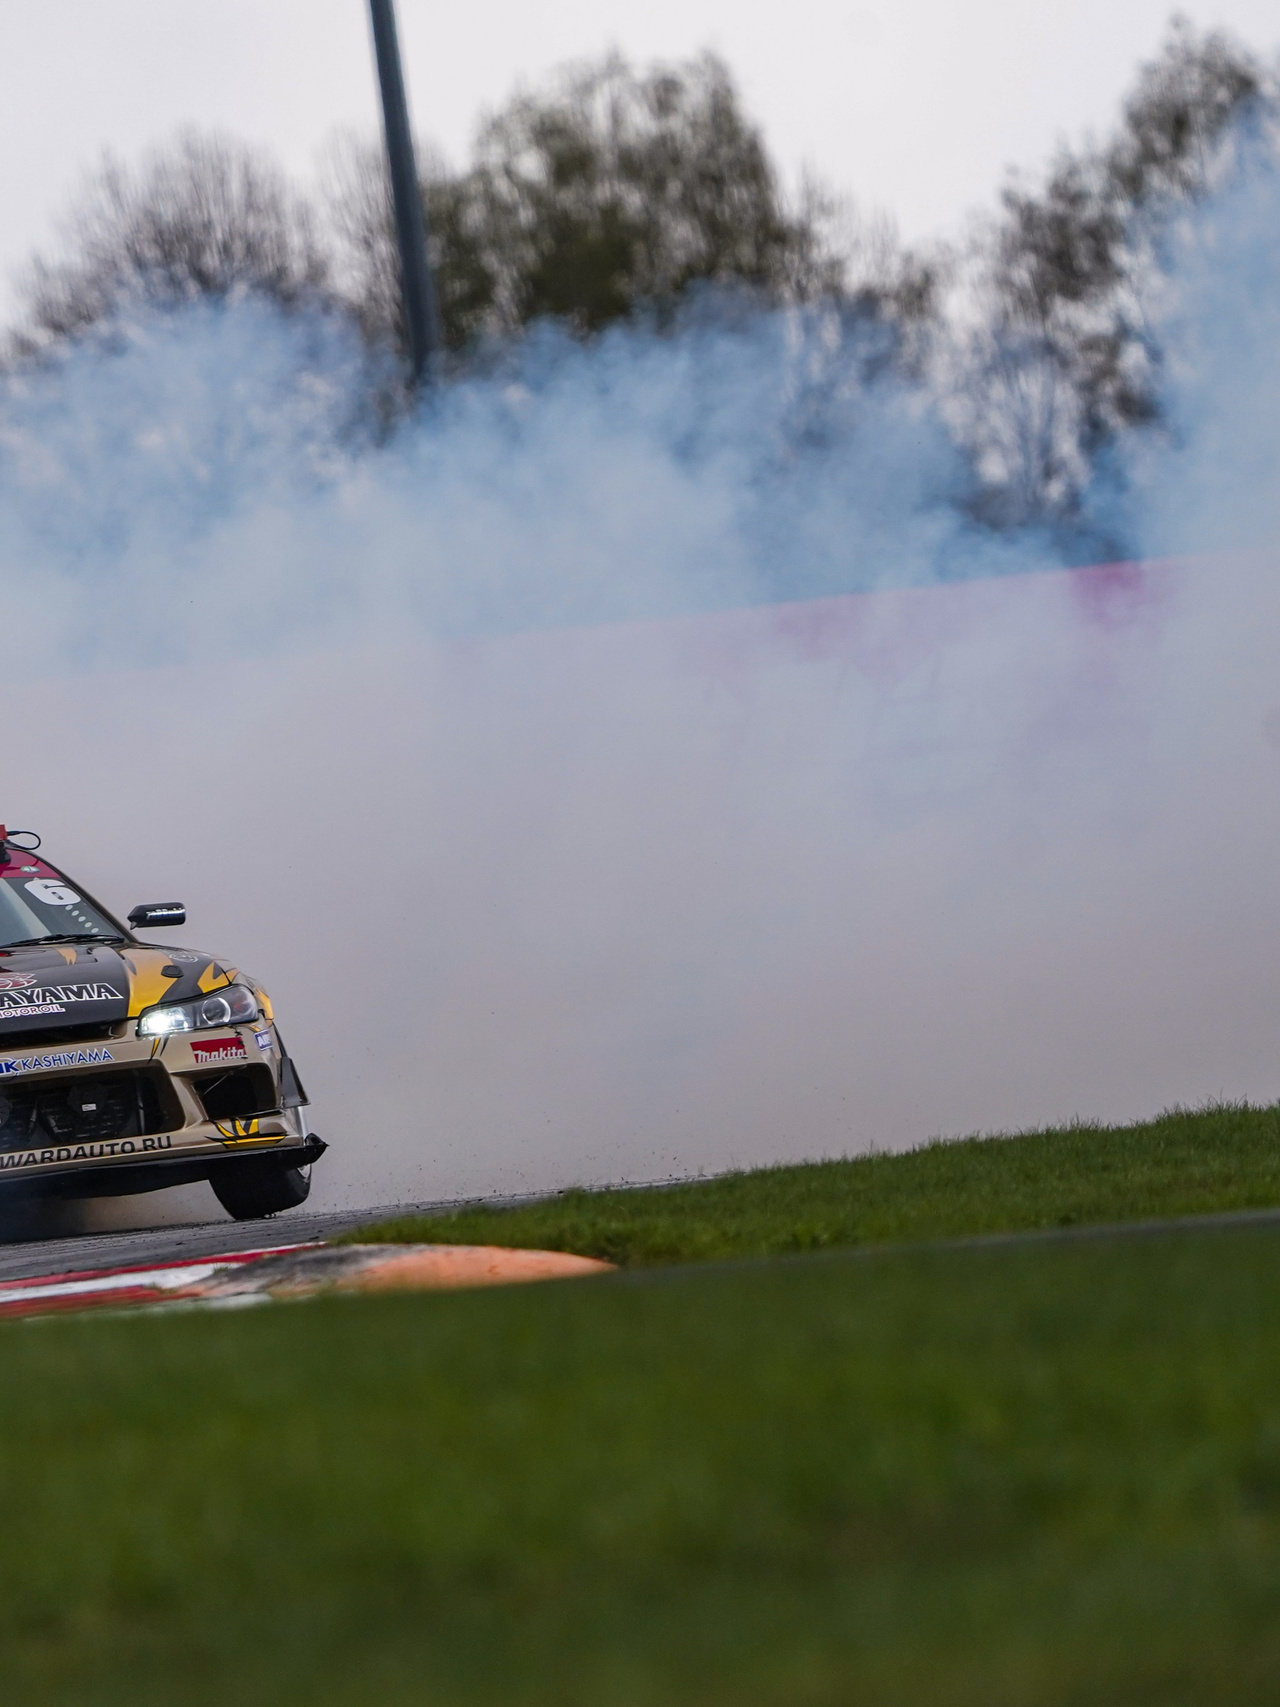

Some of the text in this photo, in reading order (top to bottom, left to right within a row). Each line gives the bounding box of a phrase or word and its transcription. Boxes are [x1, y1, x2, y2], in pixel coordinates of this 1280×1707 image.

[24, 878, 81, 906] 6
[41, 1003, 66, 1013] OIL
[21, 1048, 114, 1071] KASHIYAMA
